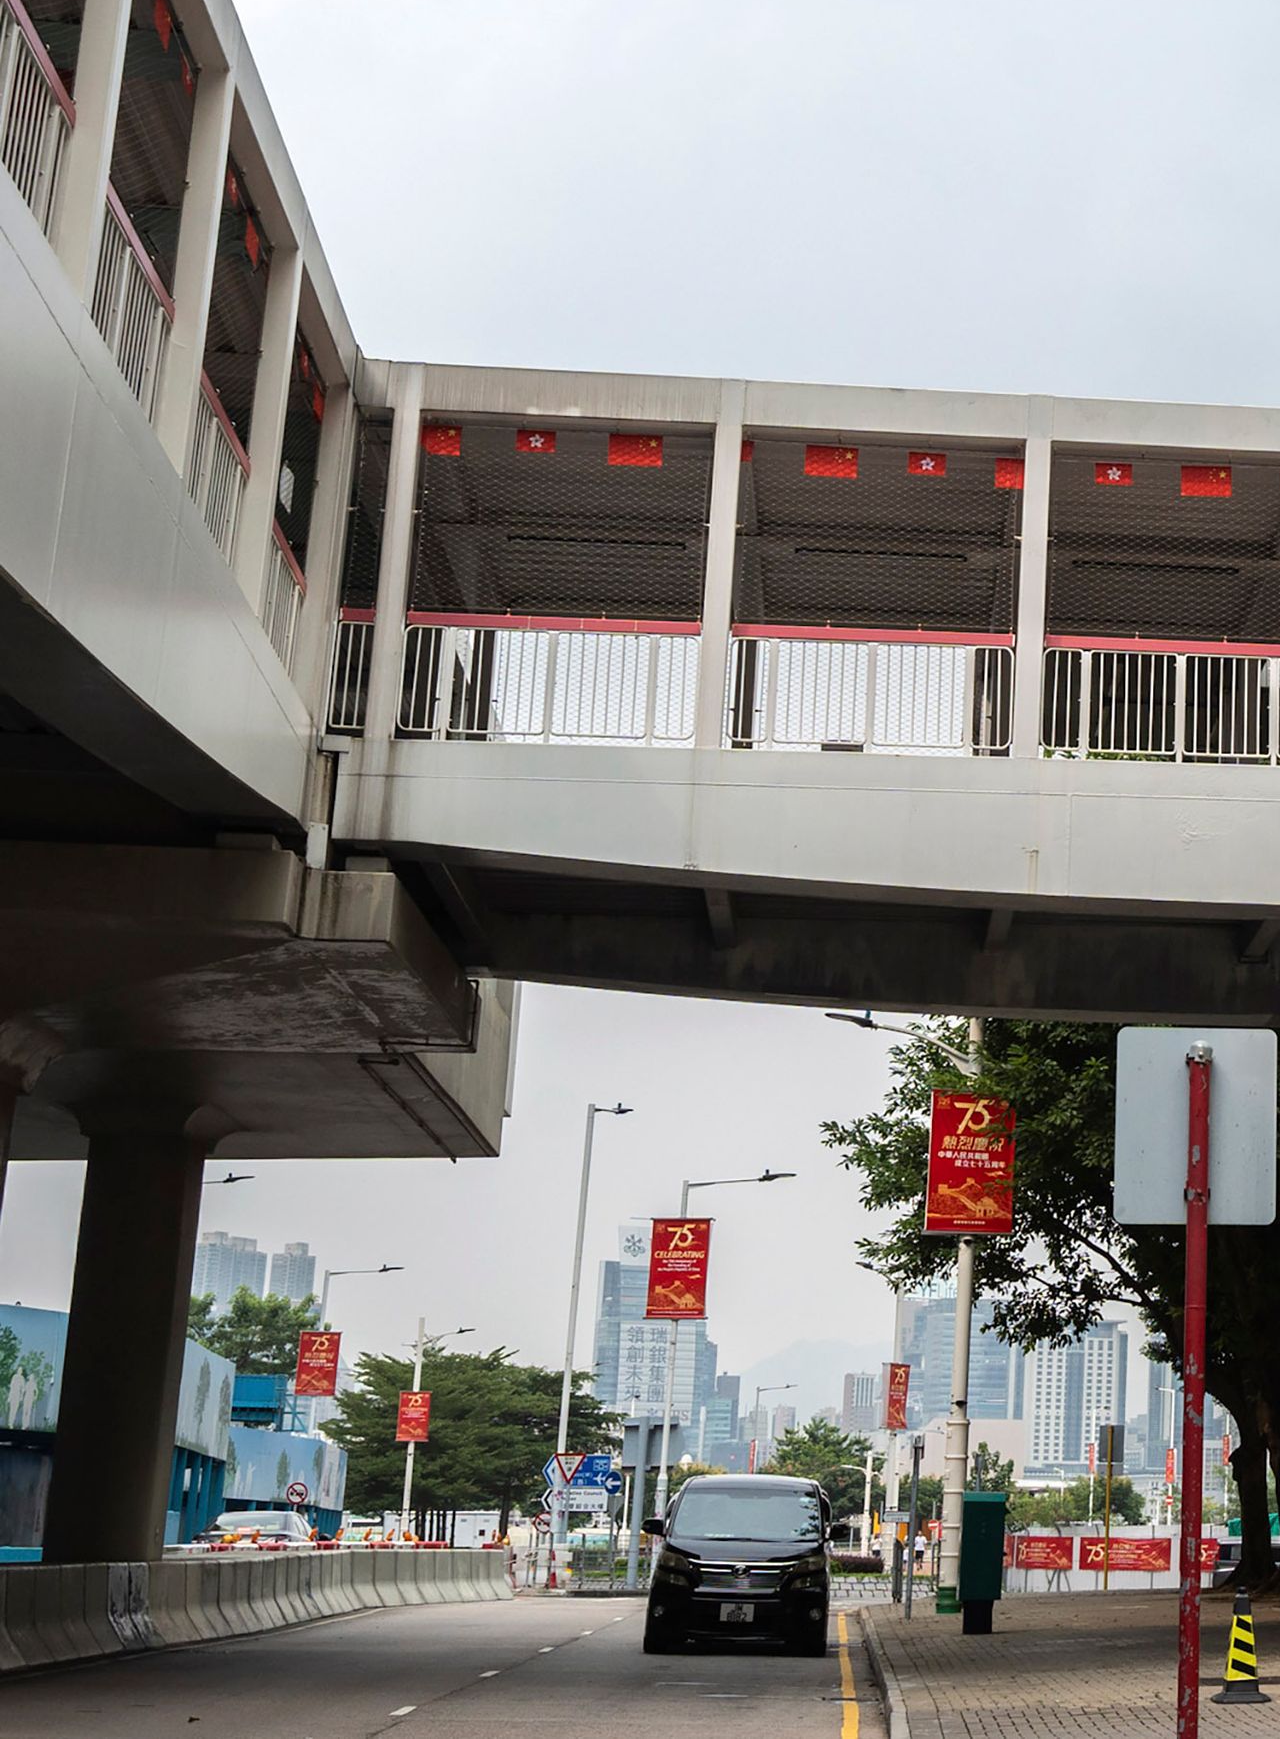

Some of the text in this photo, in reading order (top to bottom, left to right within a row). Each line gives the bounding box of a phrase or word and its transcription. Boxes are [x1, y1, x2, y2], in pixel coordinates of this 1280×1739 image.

[954, 1099, 995, 1134] 75
[667, 1223, 697, 1250] 75
[654, 1250, 705, 1259] CELEBRATING
[311, 1334, 332, 1351] 75
[408, 1393, 423, 1407] 75
[1086, 1544, 1106, 1563] 75
